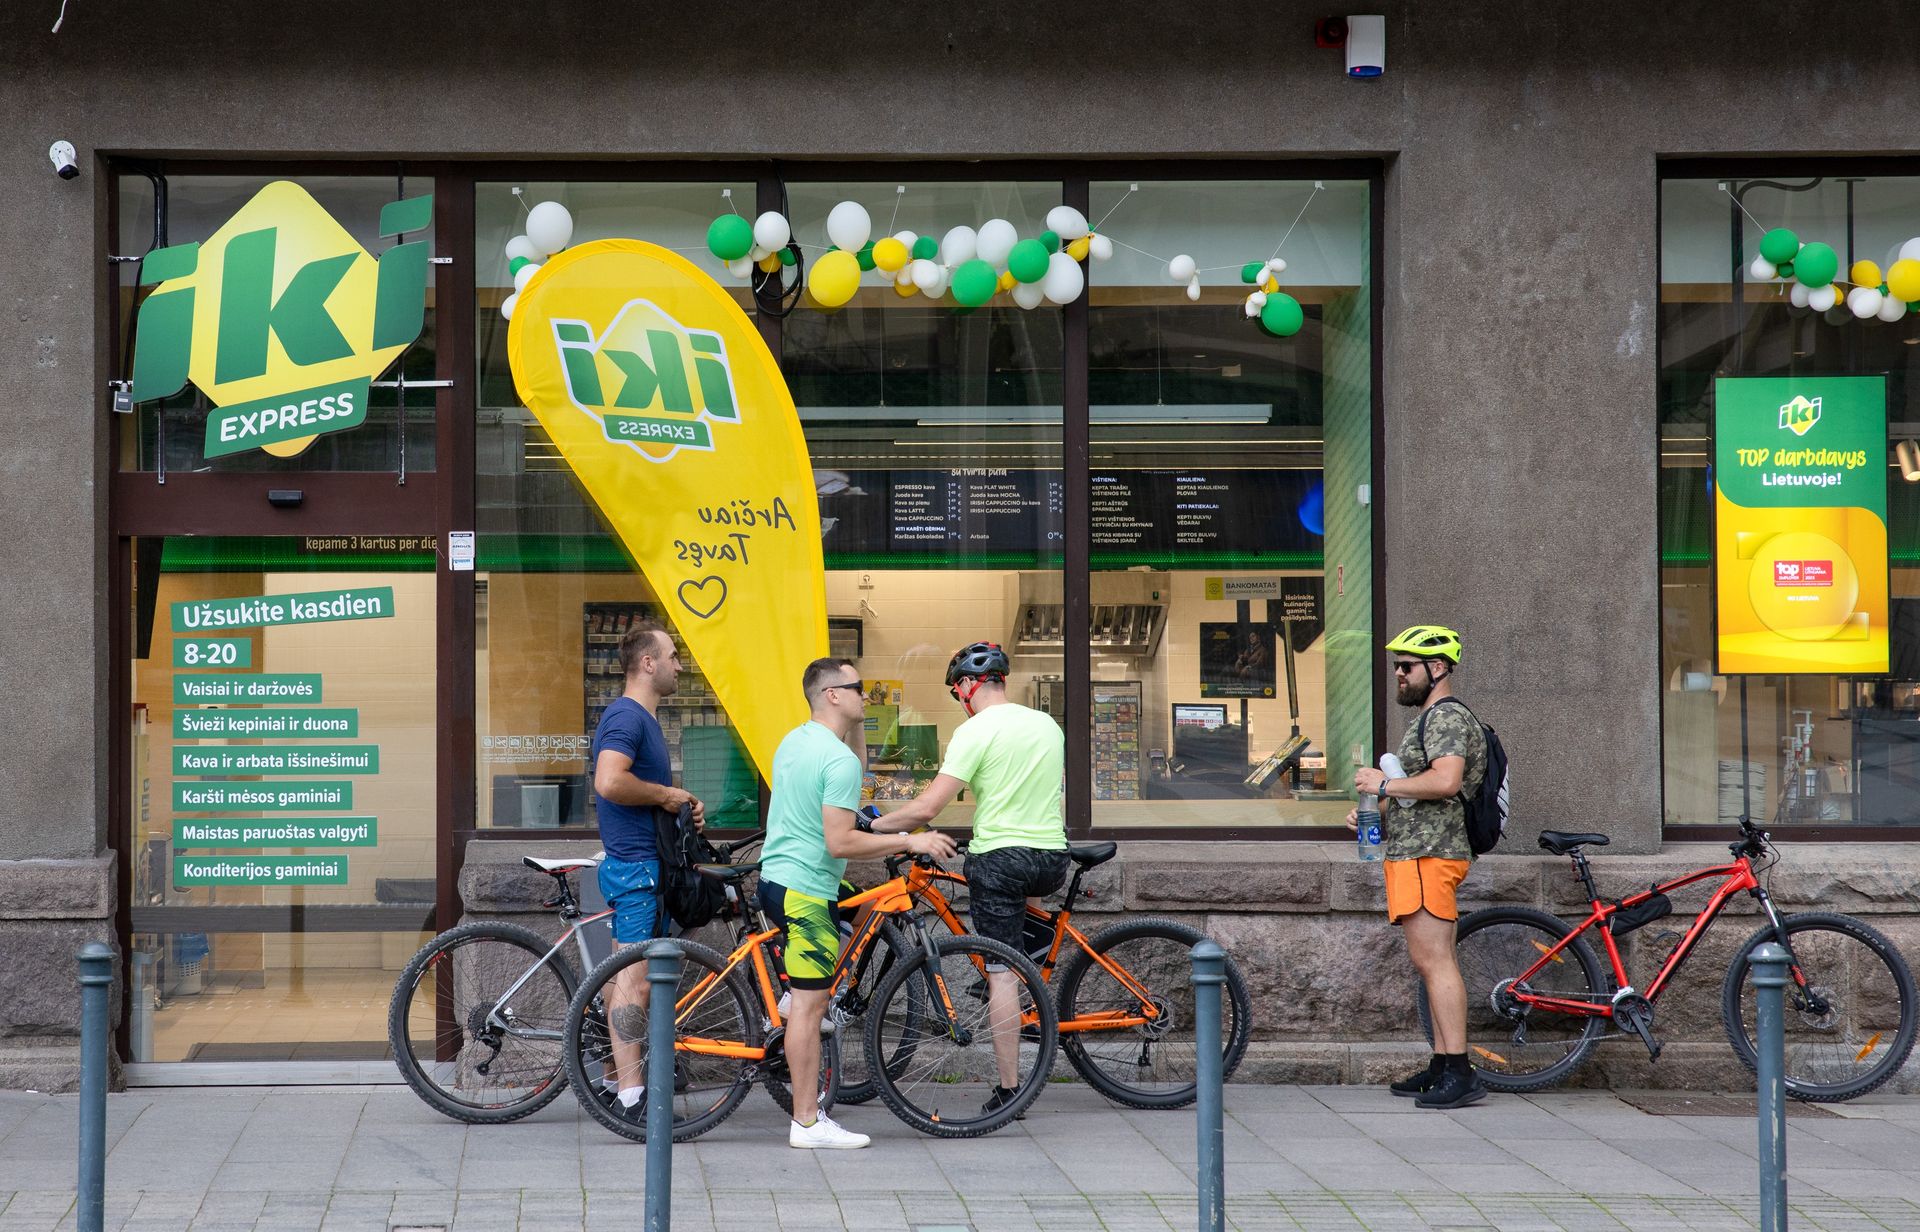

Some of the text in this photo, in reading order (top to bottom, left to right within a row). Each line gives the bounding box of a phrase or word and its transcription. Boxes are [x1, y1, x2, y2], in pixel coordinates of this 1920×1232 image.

[132, 194, 433, 404] iki
[219, 392, 354, 443] EXPRESS
[1780, 397, 1822, 428] iki
[1736, 448, 1867, 469] TOP darbdavys
[1762, 473, 1842, 487] Lietuvoje!
[306, 537, 437, 551] kepame 3 kartus per die
[182, 592, 381, 628] Užsukite kasdien
[184, 643, 237, 665] 8-20
[182, 681, 313, 696] Vaisiai ir daržovės
[182, 714, 348, 734] Švieži kepiniai ir duona
[182, 752, 369, 768] Kava ir arbata išsinešimui
[182, 788, 341, 806] Karšti mėsos gaminiai
[182, 824, 368, 842] Maistas paruoštas valgyti
[184, 862, 338, 880] Konditerijos gaminiai
